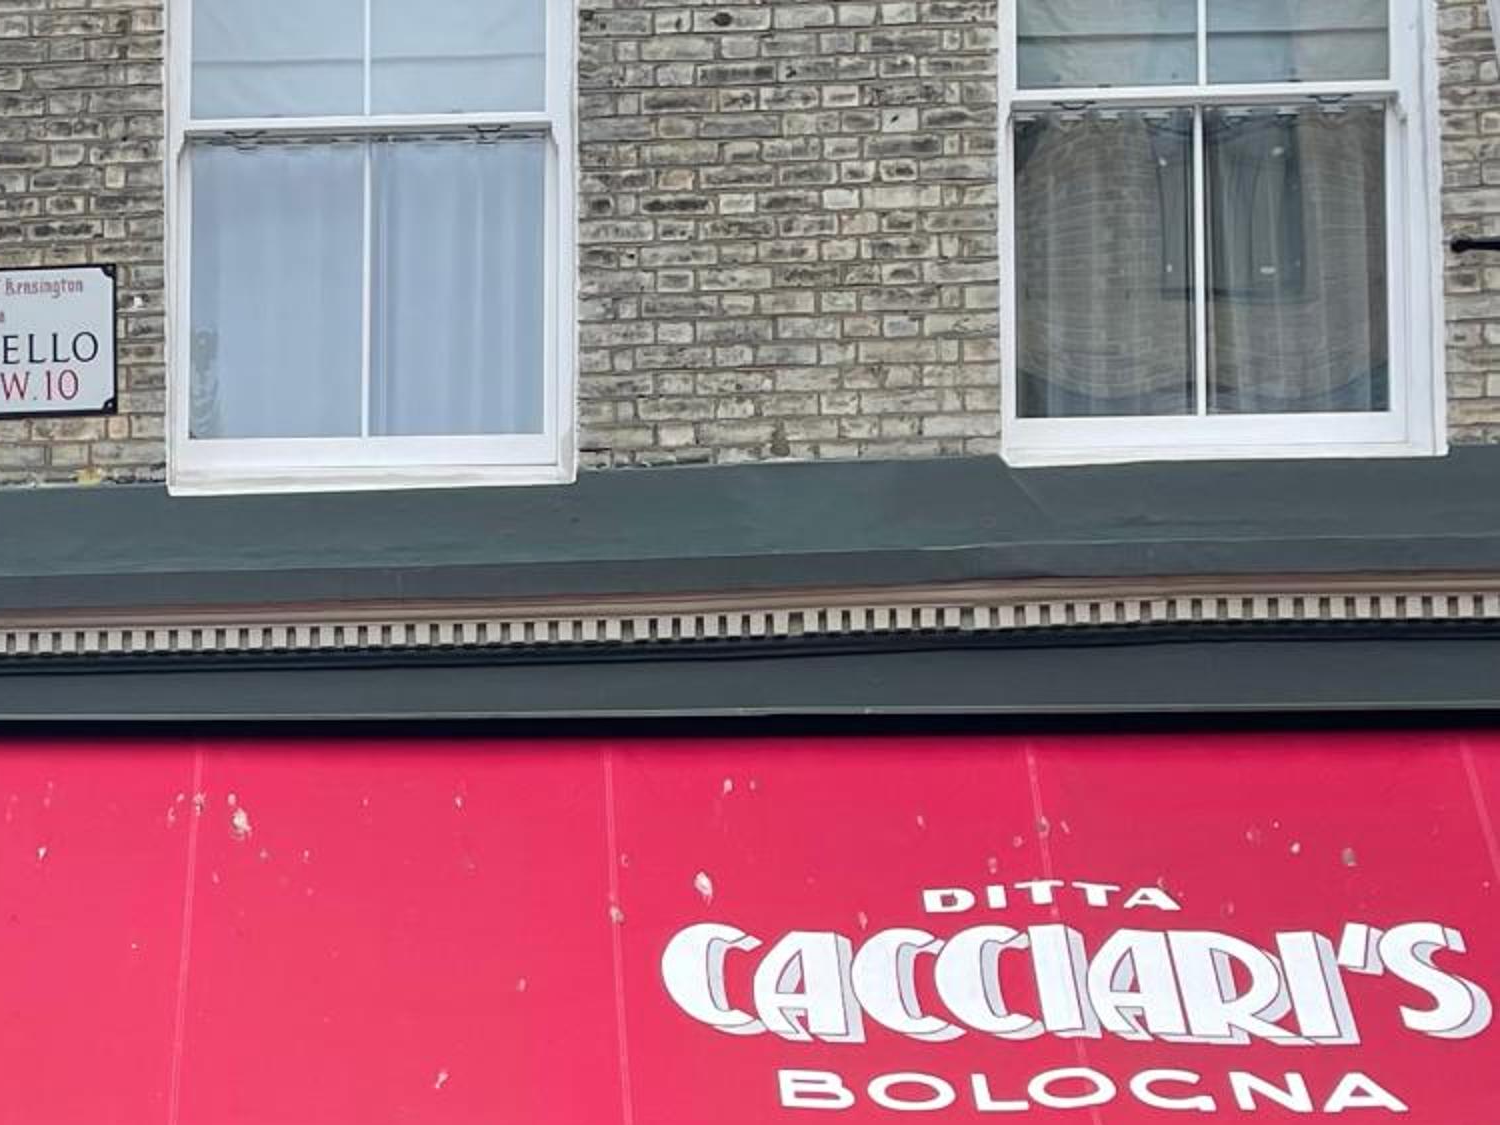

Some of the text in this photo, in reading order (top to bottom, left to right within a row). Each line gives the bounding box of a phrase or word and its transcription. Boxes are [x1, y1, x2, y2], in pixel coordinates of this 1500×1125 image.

[5, 277, 84, 299] Kensington
[921, 878, 1182, 914] DITTA
[660, 921, 1494, 1047] CACCIARI'S
[776, 1066, 1409, 1114] BOLOGNA
